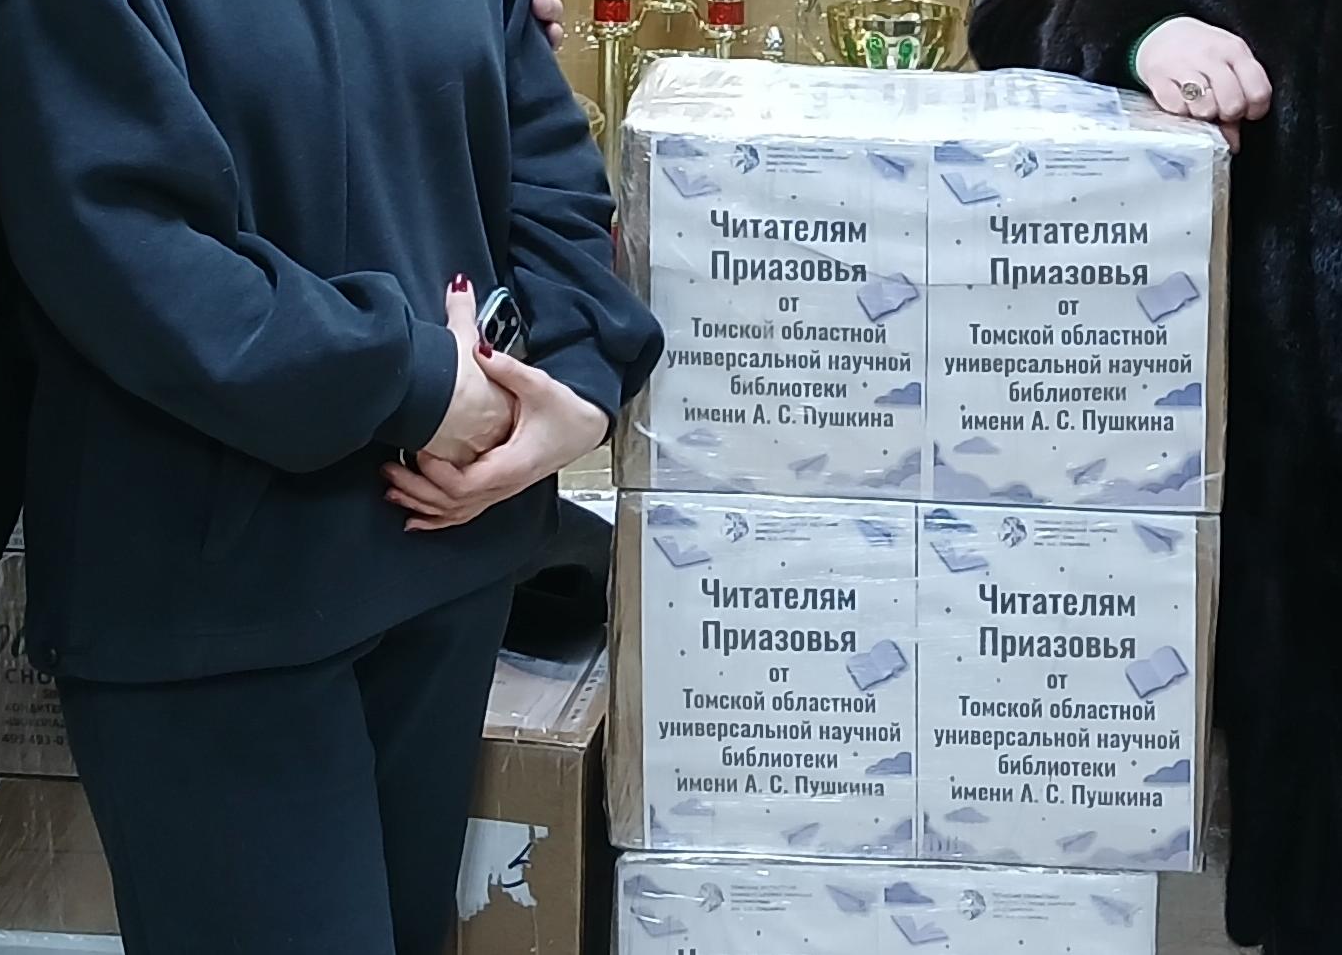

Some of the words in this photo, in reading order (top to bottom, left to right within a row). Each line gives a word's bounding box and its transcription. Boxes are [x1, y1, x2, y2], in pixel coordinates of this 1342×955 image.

[711, 210, 866, 242] Читателям
[990, 216, 1147, 244] Читателям
[712, 251, 866, 285] Приазовья
[991, 258, 1147, 289] Приазовья
[779, 297, 799, 312] от
[1059, 300, 1079, 315] от
[691, 317, 773, 339] Томской
[782, 321, 885, 343] областной
[969, 324, 1053, 345] Томской
[1062, 324, 1167, 345] областной
[667, 350, 820, 371] универсальной
[829, 353, 910, 374] научной
[945, 355, 1100, 377] универсальной
[1109, 354, 1191, 376] научной
[731, 375, 846, 398] библиотеки
[1010, 381, 1126, 402] библиотеки
[685, 407, 745, 423] имени
[753, 404, 770, 424] А.
[779, 405, 796, 424] С.
[804, 406, 893, 428] Пушкина
[962, 415, 1023, 430] имени
[1032, 411, 1049, 430] А.
[1057, 410, 1074, 430] С.
[1083, 410, 1173, 434] Пушкина
[702, 579, 855, 610] Читателям
[979, 584, 1135, 616] Читателям
[703, 621, 855, 656] Приазовья
[980, 627, 1135, 663] Приазовья
[770, 668, 789, 682] от
[1047, 674, 1067, 689] от
[683, 689, 764, 710] Томской
[773, 691, 875, 713] областной
[959, 696, 1042, 718] Томской
[1050, 698, 1155, 720] областной
[659, 721, 811, 741] универсальной
[820, 723, 900, 744] научной
[934, 728, 1089, 750] универсальной
[1098, 730, 1179, 752] научной
[722, 746, 837, 768] библиотеки
[999, 754, 1115, 778] библиотеки
[678, 777, 737, 792] имени
[745, 774, 762, 793] А.
[770, 775, 788, 794] С.
[796, 776, 884, 797] Пушкина
[952, 786, 1012, 802] имени
[1021, 784, 1038, 802] А.
[1047, 784, 1064, 803] С.
[1072, 785, 1162, 808] Пушкина
